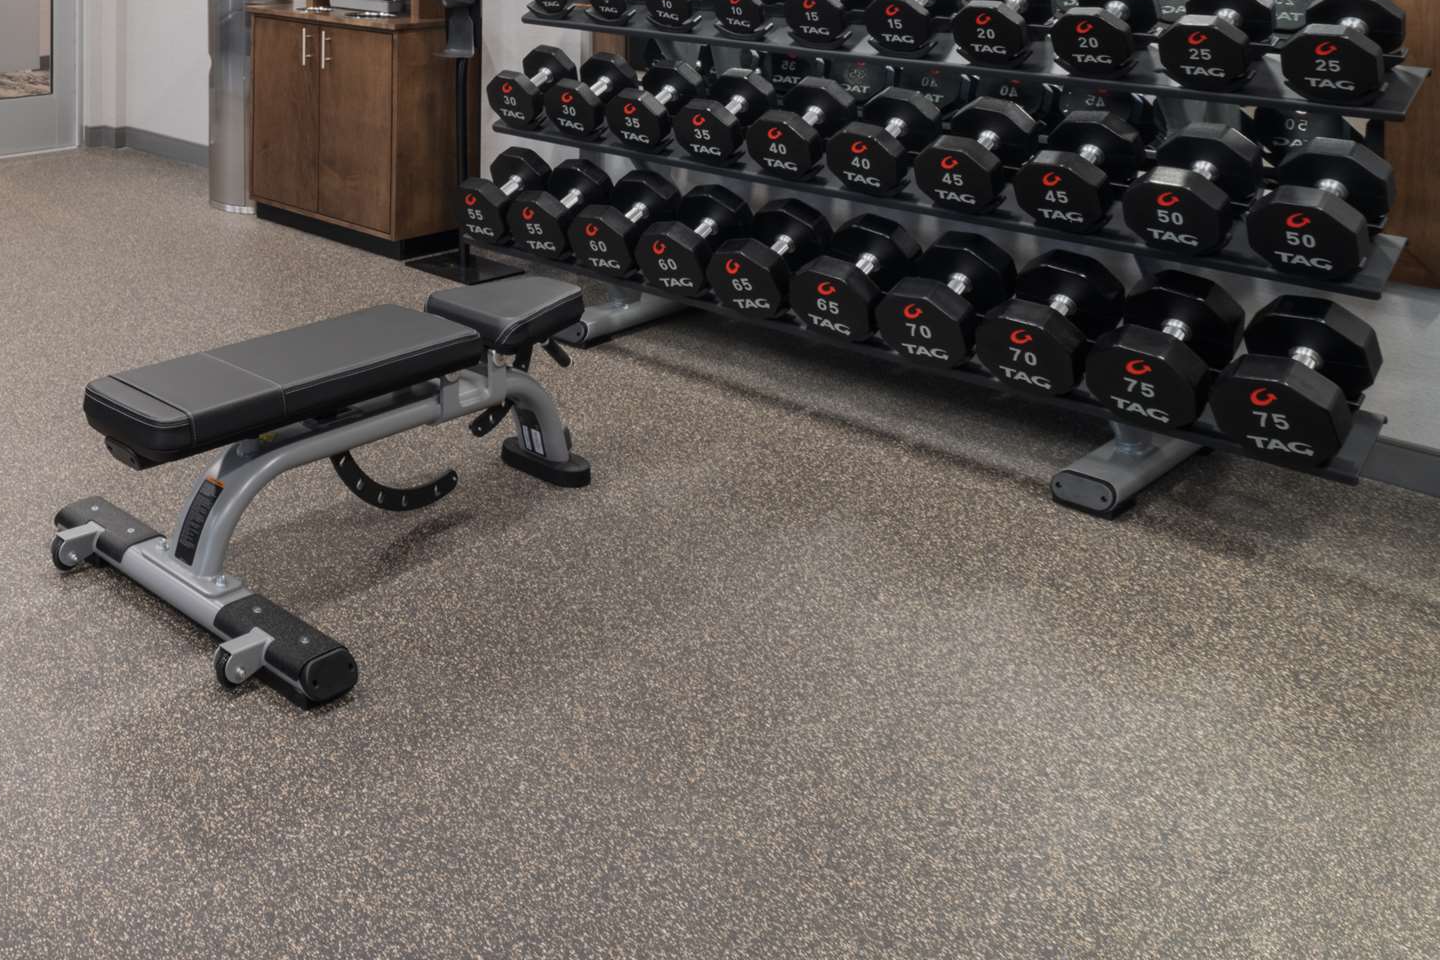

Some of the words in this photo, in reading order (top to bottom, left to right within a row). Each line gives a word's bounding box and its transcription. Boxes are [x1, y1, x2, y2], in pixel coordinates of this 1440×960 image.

[541, 0, 561, 8] TAG
[599, 4, 618, 13] TAG
[662, 0, 672, 8] 10
[655, 10, 679, 21] TAG
[729, 6, 742, 17] 10
[806, 12, 819, 21] 15
[725, 17, 750, 28] TAG
[888, 19, 902, 29] 15
[800, 26, 829, 35] TAG
[977, 28, 995, 39] 20
[882, 34, 914, 43] TAG
[1078, 37, 1098, 48] 20
[971, 44, 1006, 54] TAG
[1189, 48, 1211, 60] 25
[1072, 54, 1112, 64] TAG
[1180, 66, 1225, 77] TAG
[1316, 59, 1340, 72] 25
[1304, 77, 1354, 91] TAG
[504, 96, 516, 106] 30
[498, 109, 525, 120] TAG
[561, 105, 576, 117] 30
[556, 118, 584, 131] TAG
[625, 117, 640, 128] 35
[620, 131, 649, 143] TAG
[694, 129, 710, 140] 35
[689, 144, 721, 156] TAG
[769, 143, 786, 154] 40
[762, 158, 797, 171] TAG
[850, 157, 870, 171] 40
[842, 172, 880, 187] TAG
[942, 173, 963, 186] 45
[934, 189, 976, 204] TAG
[1045, 190, 1068, 203] 45
[468, 209, 483, 220] 55
[1038, 208, 1083, 222] TAG
[1157, 210, 1183, 225] 50
[464, 224, 494, 237] TAG
[526, 224, 543, 235] 55
[1145, 228, 1198, 247] TAG
[1286, 232, 1315, 248] 50
[526, 241, 556, 250] TAG
[590, 240, 607, 252] 60
[589, 258, 620, 269] TAG
[658, 259, 677, 270] 60
[1273, 251, 1332, 272] TAG
[659, 278, 693, 287] TAG
[732, 278, 752, 291] 65
[733, 299, 770, 308] TAG
[817, 298, 839, 314] 65
[807, 313, 850, 335] TAG
[906, 323, 931, 338] 70
[901, 343, 948, 360] TAG
[1009, 347, 1037, 366] 70
[998, 365, 1051, 389] TAG
[1124, 377, 1154, 399] 75
[1111, 395, 1169, 423] TAG
[1253, 411, 1289, 430] 75
[1247, 435, 1314, 456] TAG
